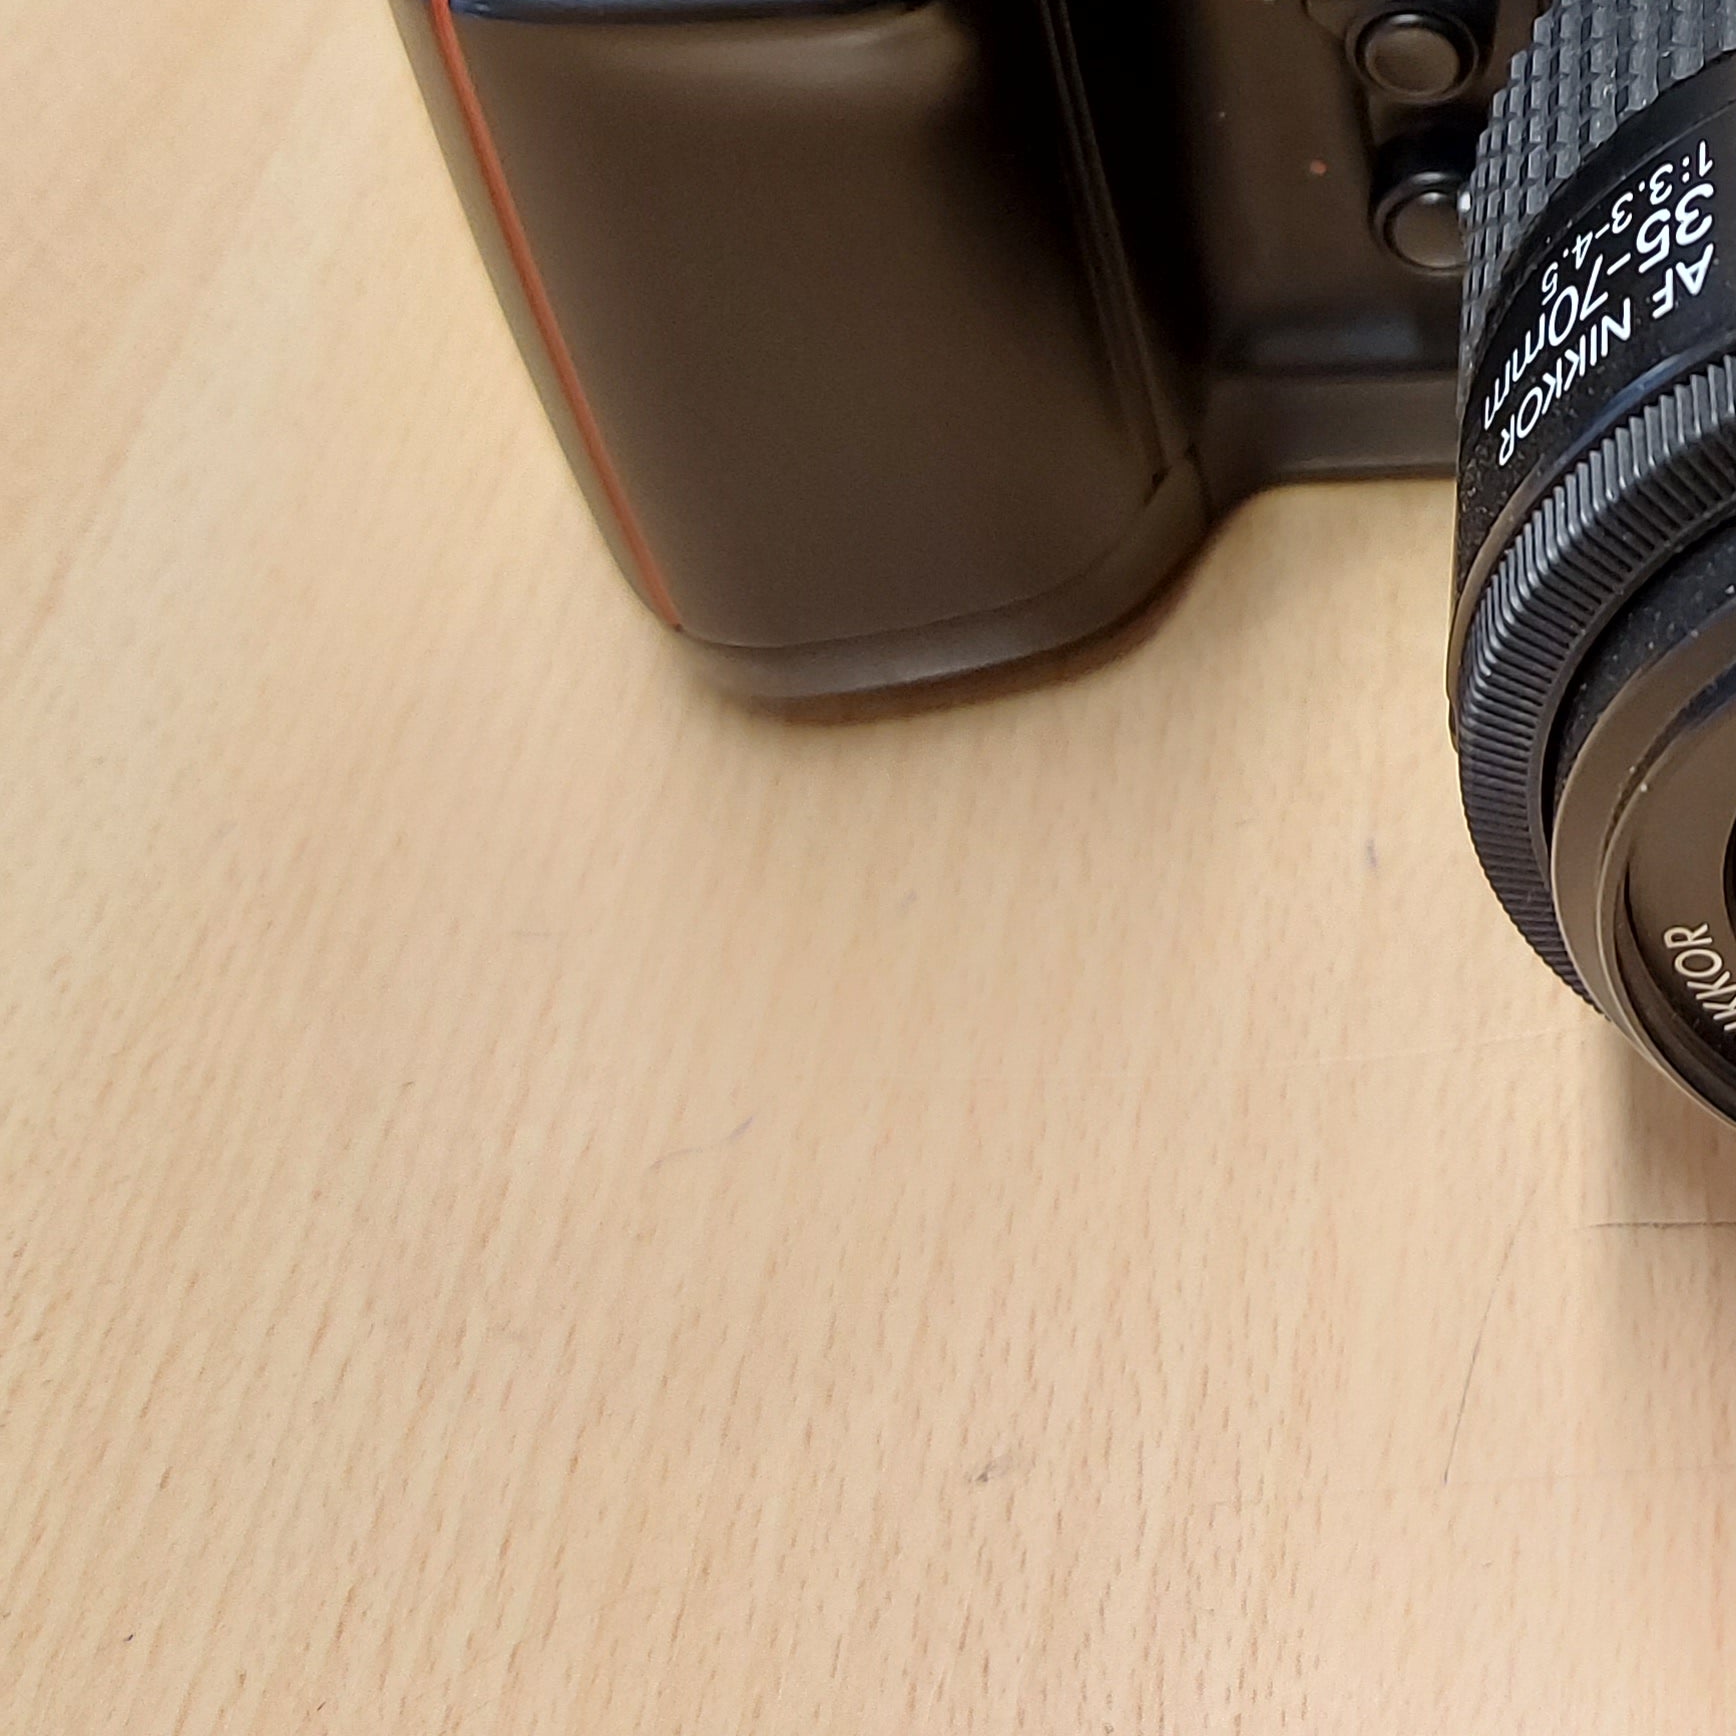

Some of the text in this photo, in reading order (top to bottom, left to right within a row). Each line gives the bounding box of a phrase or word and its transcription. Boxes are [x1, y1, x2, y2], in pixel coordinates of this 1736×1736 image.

[1483, 182, 1715, 431] 35-70mm
[1540, 140, 1714, 306] 1:3.3-4.5
[1498, 243, 1715, 467] AF NIKKOR
